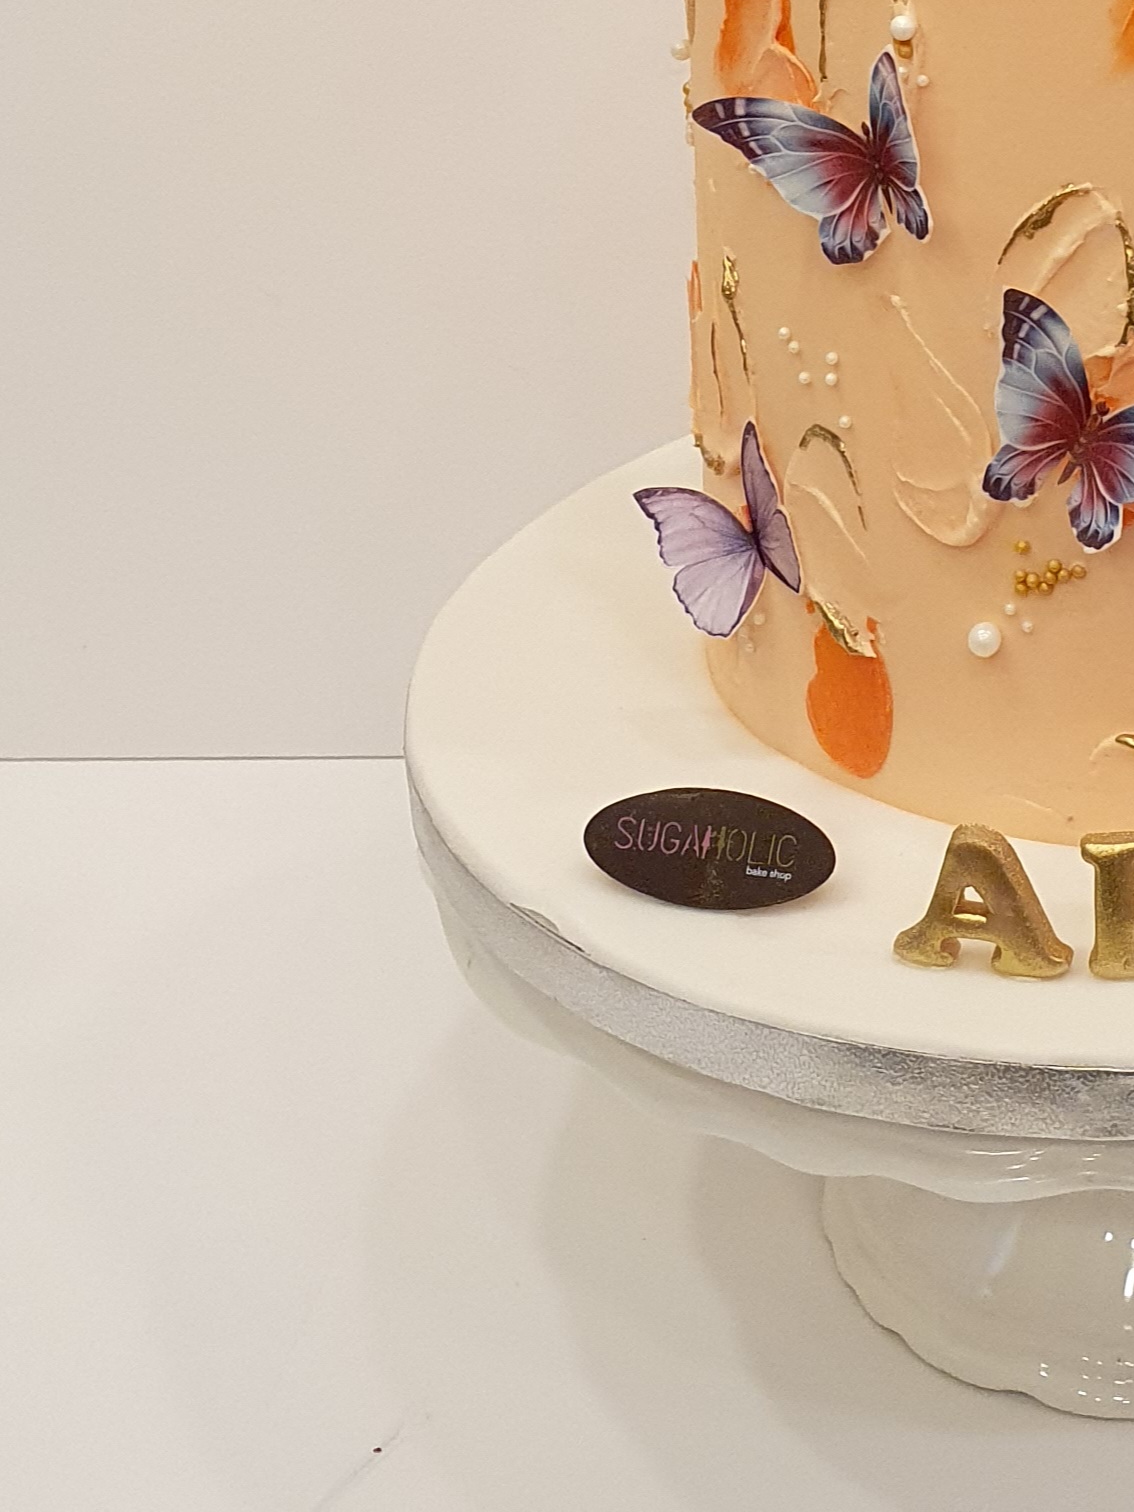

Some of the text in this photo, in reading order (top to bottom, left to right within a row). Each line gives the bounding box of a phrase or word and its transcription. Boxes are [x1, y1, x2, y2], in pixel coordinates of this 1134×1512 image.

[614, 816, 797, 867] SUGAHOLIC
[746, 865, 792, 882] bake shop
